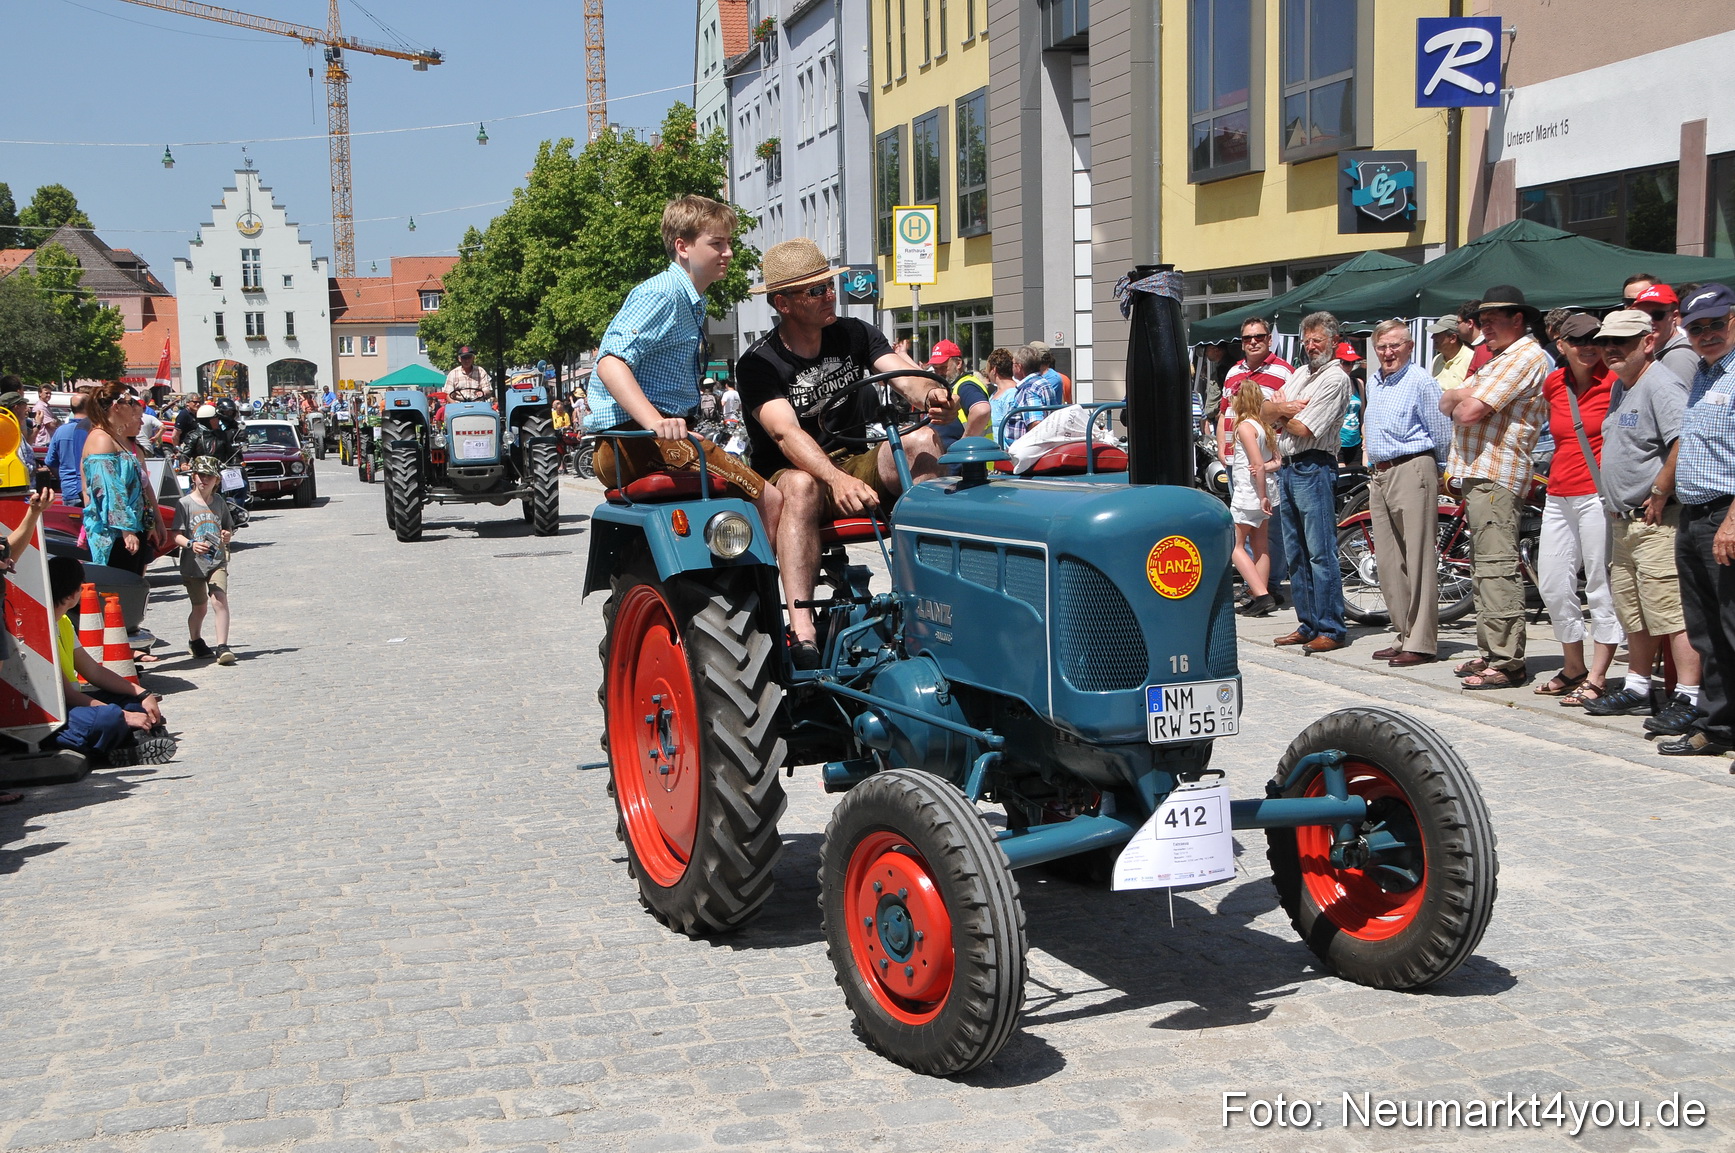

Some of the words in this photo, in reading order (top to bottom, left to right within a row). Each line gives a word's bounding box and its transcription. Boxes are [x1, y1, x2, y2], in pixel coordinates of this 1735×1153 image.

[1507, 130, 1534, 147] Unterer
[1535, 122, 1558, 141] Markt
[1560, 118, 1569, 135] 15
[1370, 172, 1397, 206] G2
[909, 219, 921, 237] H
[854, 275, 867, 291] G2
[1158, 559, 1192, 574] LANZ
[917, 598, 952, 626] LANZ
[1169, 654, 1189, 674] 16
[1153, 703, 1159, 711] D
[1164, 687, 1193, 712] NM
[1220, 705, 1233, 716] 04
[1154, 714, 1182, 739] RW
[1189, 711, 1216, 735] 55
[1222, 721, 1234, 732] 10
[1164, 806, 1207, 828] 412
